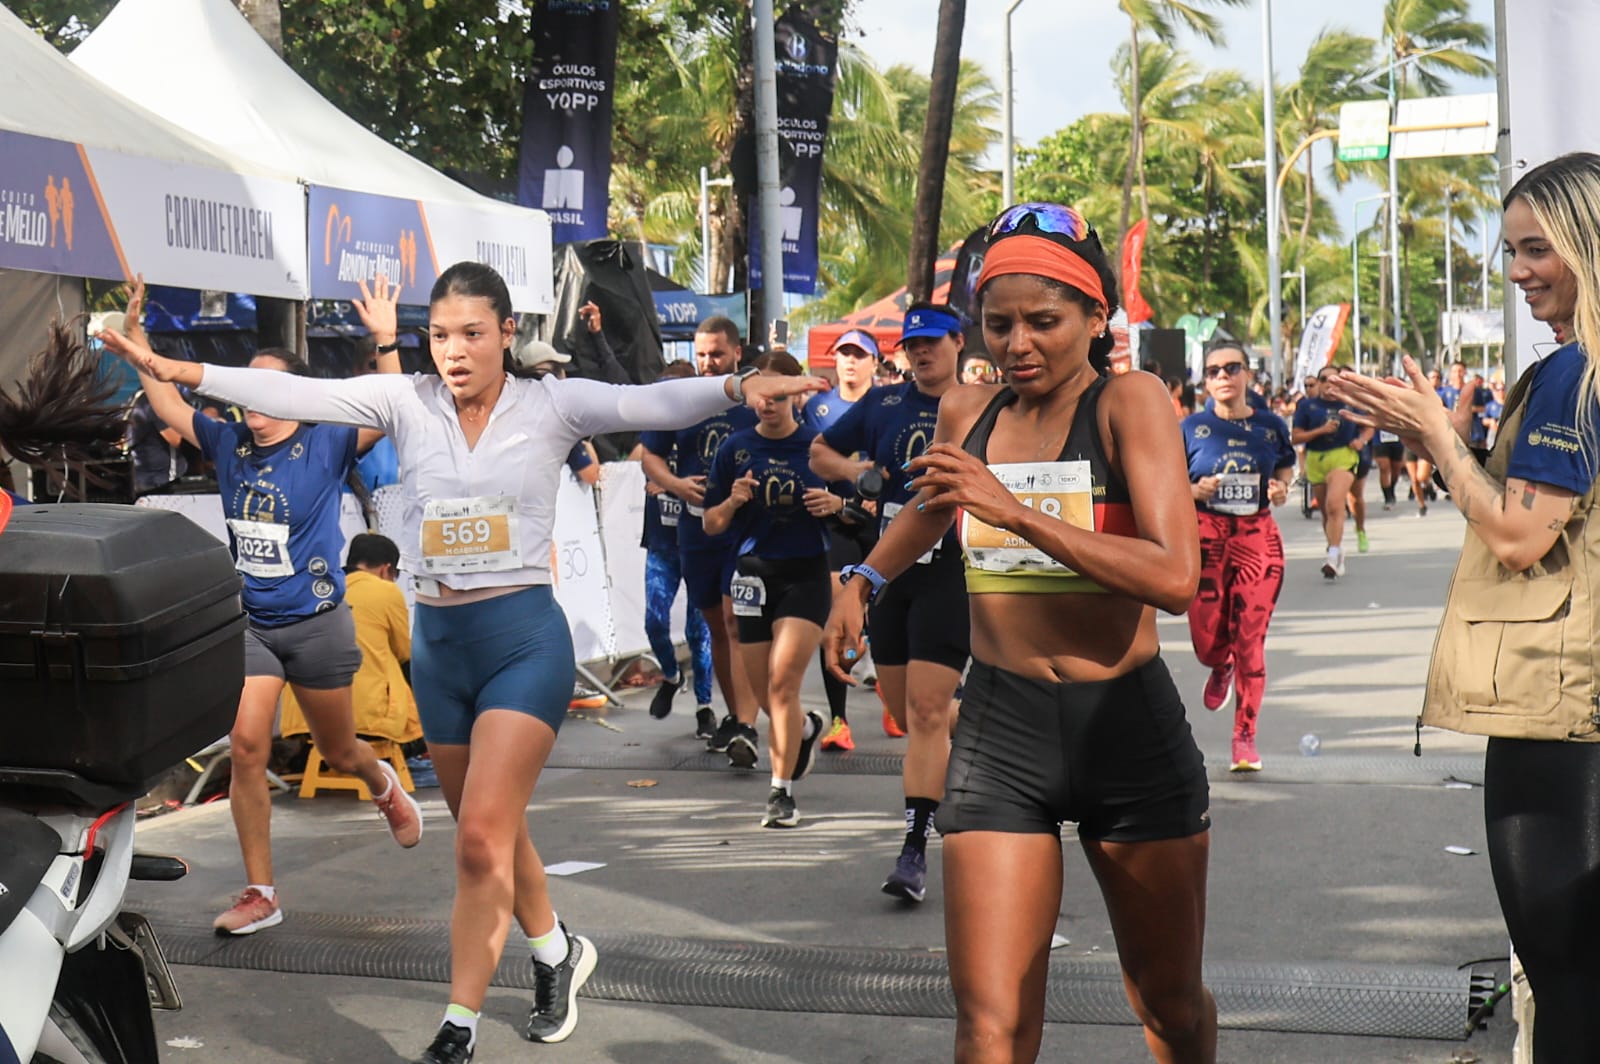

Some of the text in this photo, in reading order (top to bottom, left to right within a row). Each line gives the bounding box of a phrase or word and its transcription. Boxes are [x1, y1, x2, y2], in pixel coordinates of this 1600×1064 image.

[552, 63, 596, 77] ÓCULOS
[539, 78, 606, 92] ESPORTIVOS
[546, 91, 599, 112] YOPP
[5, 203, 47, 247] MELLO
[165, 193, 274, 261] CRONOMETRAGEM
[550, 211, 585, 226] RASIL
[663, 302, 698, 323] YOPP
[1217, 486, 1253, 500] 1838
[442, 520, 490, 545] 569
[1004, 536, 1033, 548] ADRI
[237, 537, 276, 558] 2022
[562, 547, 588, 580] 30
